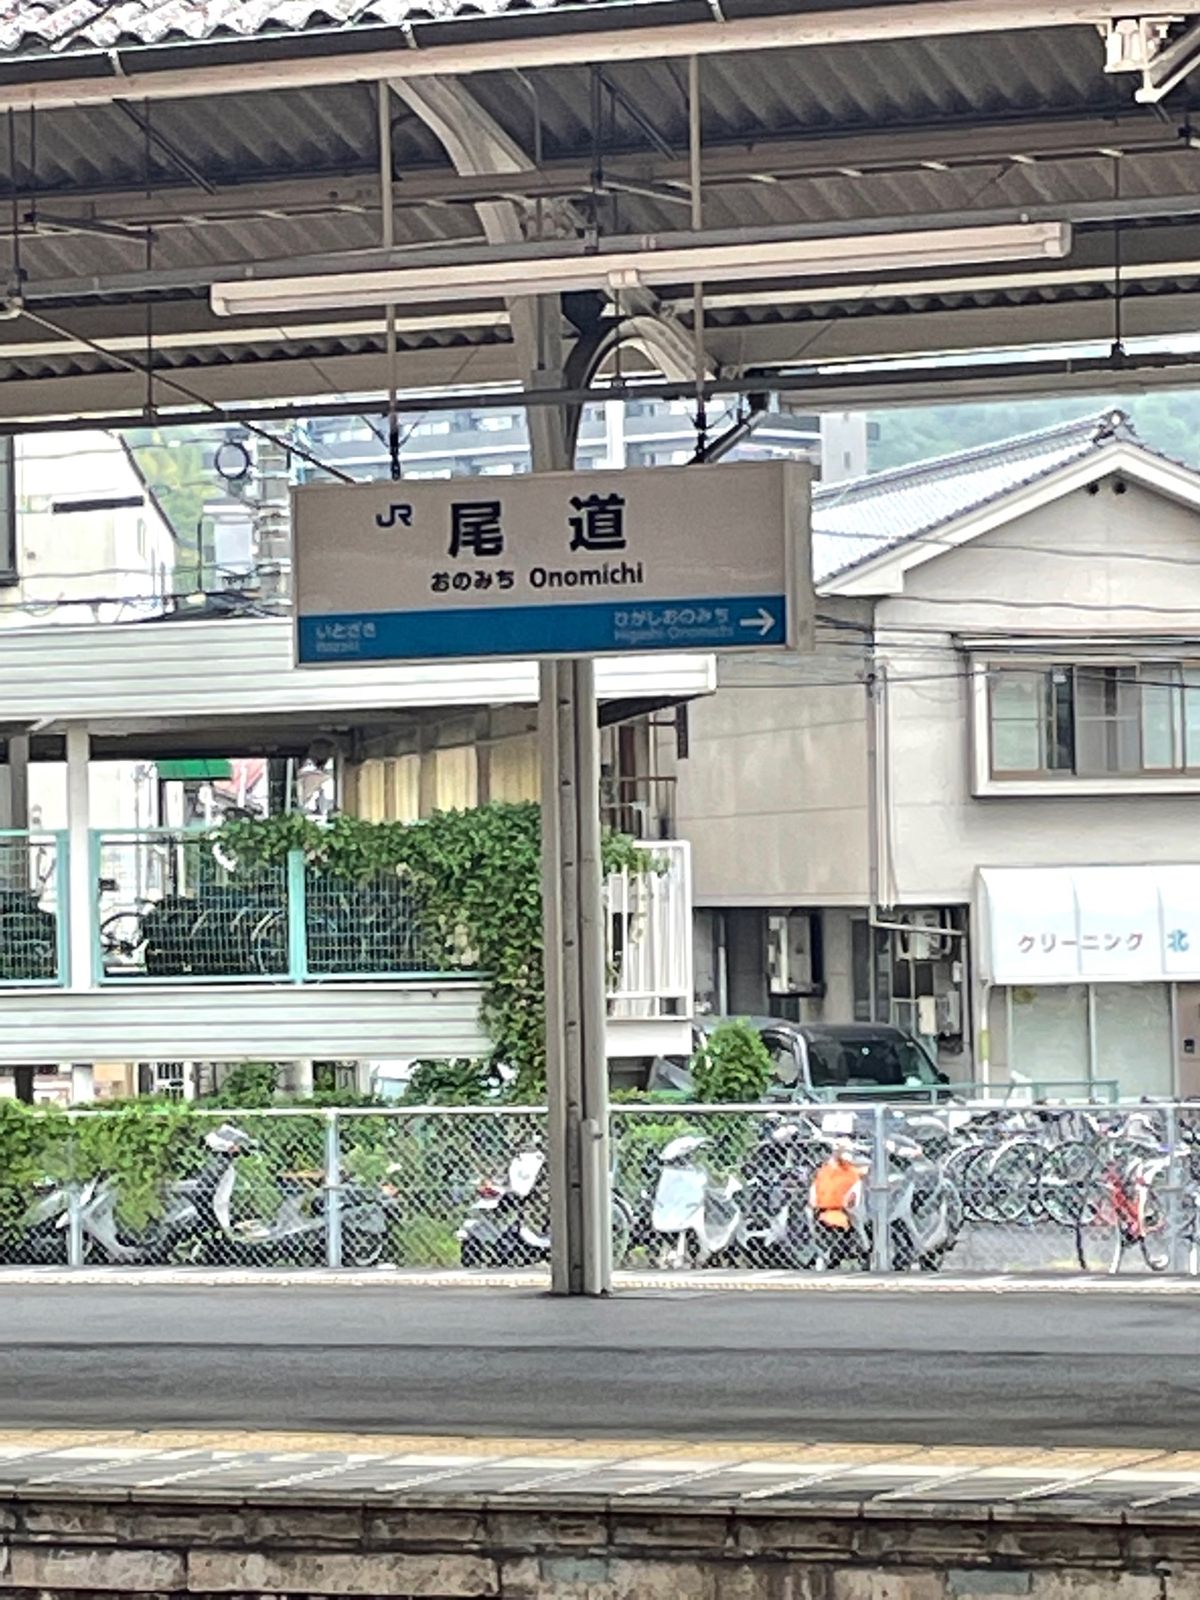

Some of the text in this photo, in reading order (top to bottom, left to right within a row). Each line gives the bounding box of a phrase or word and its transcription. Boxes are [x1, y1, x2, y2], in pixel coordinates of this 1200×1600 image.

[375, 504, 412, 528] JR
[448, 493, 627, 557] 尾道
[431, 570, 514, 592] おのみち
[529, 561, 644, 588] Onomichi
